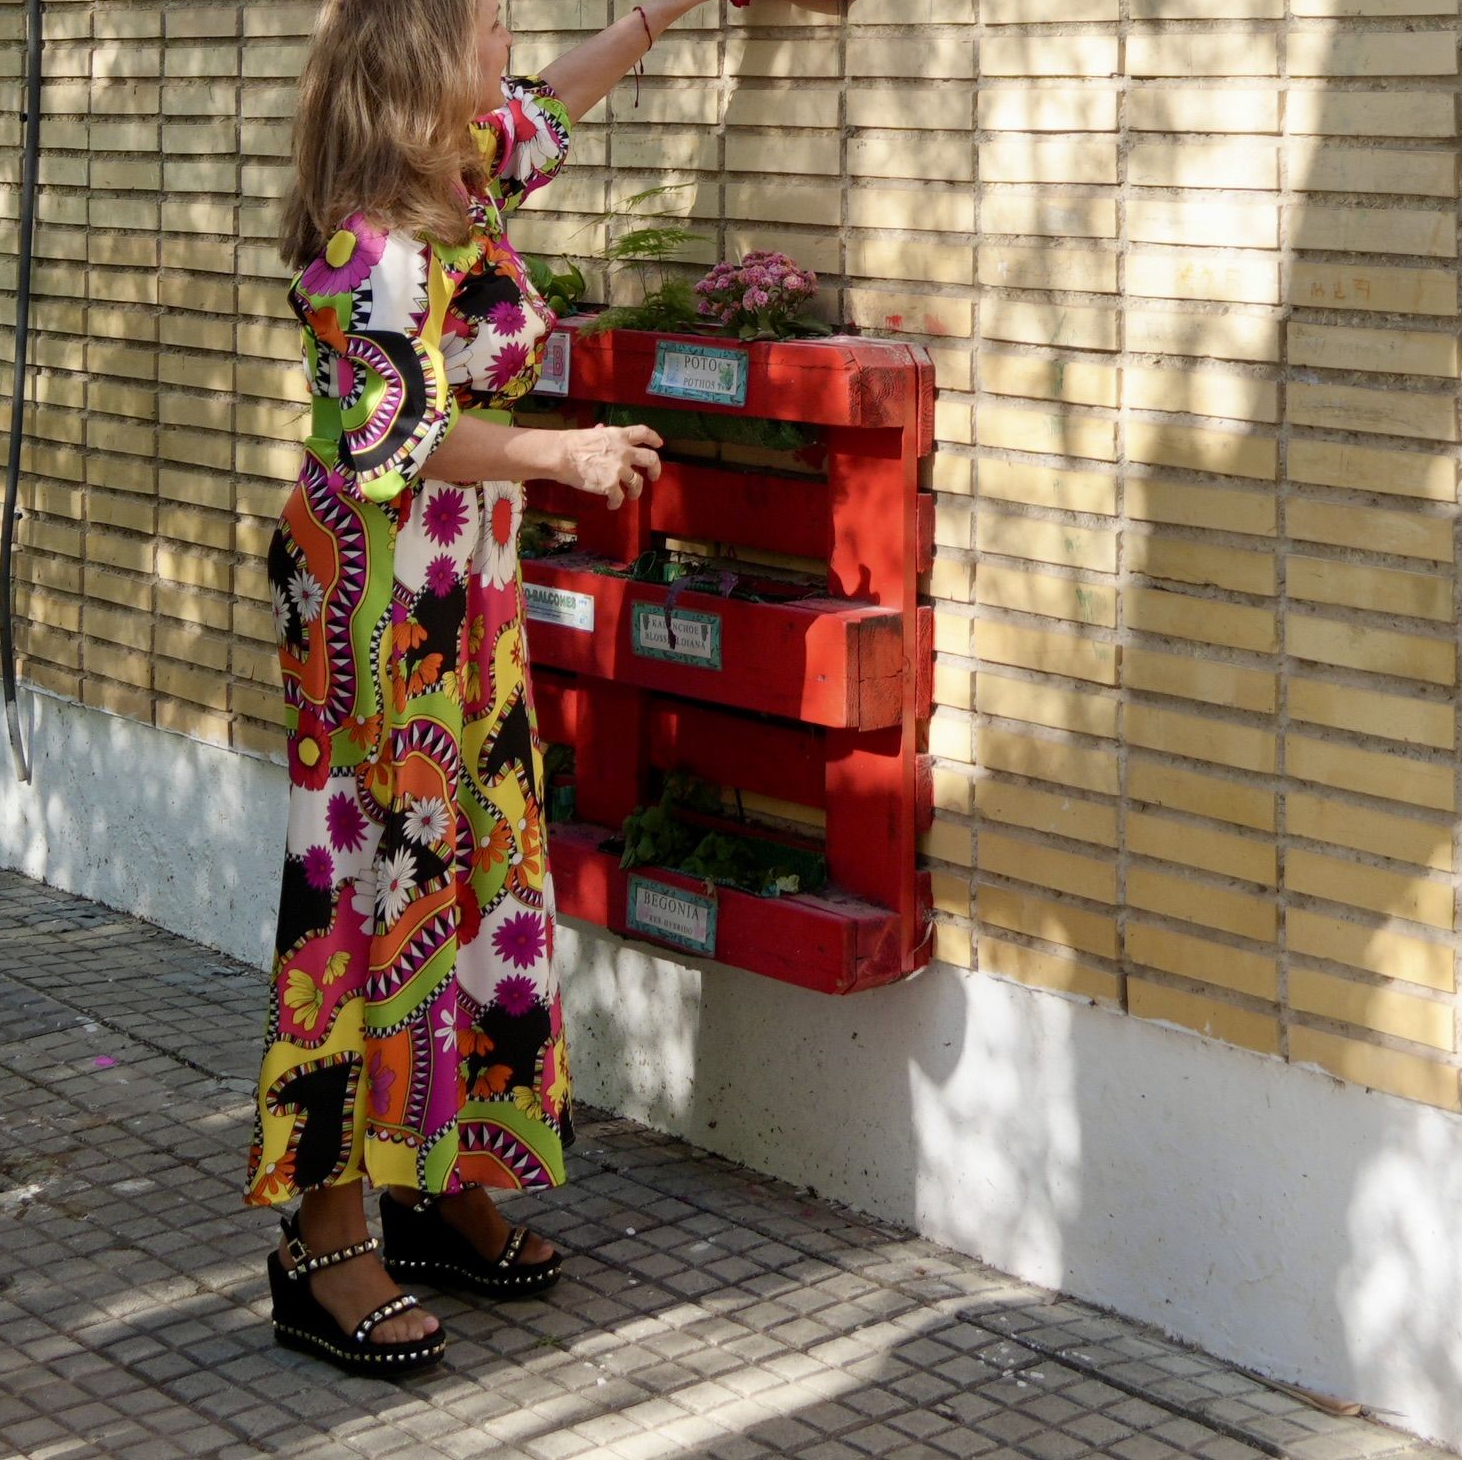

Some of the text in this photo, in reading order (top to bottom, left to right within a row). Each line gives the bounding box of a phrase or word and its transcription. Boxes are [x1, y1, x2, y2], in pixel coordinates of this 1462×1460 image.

[684, 356, 717, 372] POTO
[683, 377, 715, 389] POTHOS
[652, 619, 699, 635] KALNCHOE
[644, 891, 699, 920] BEGONIA
